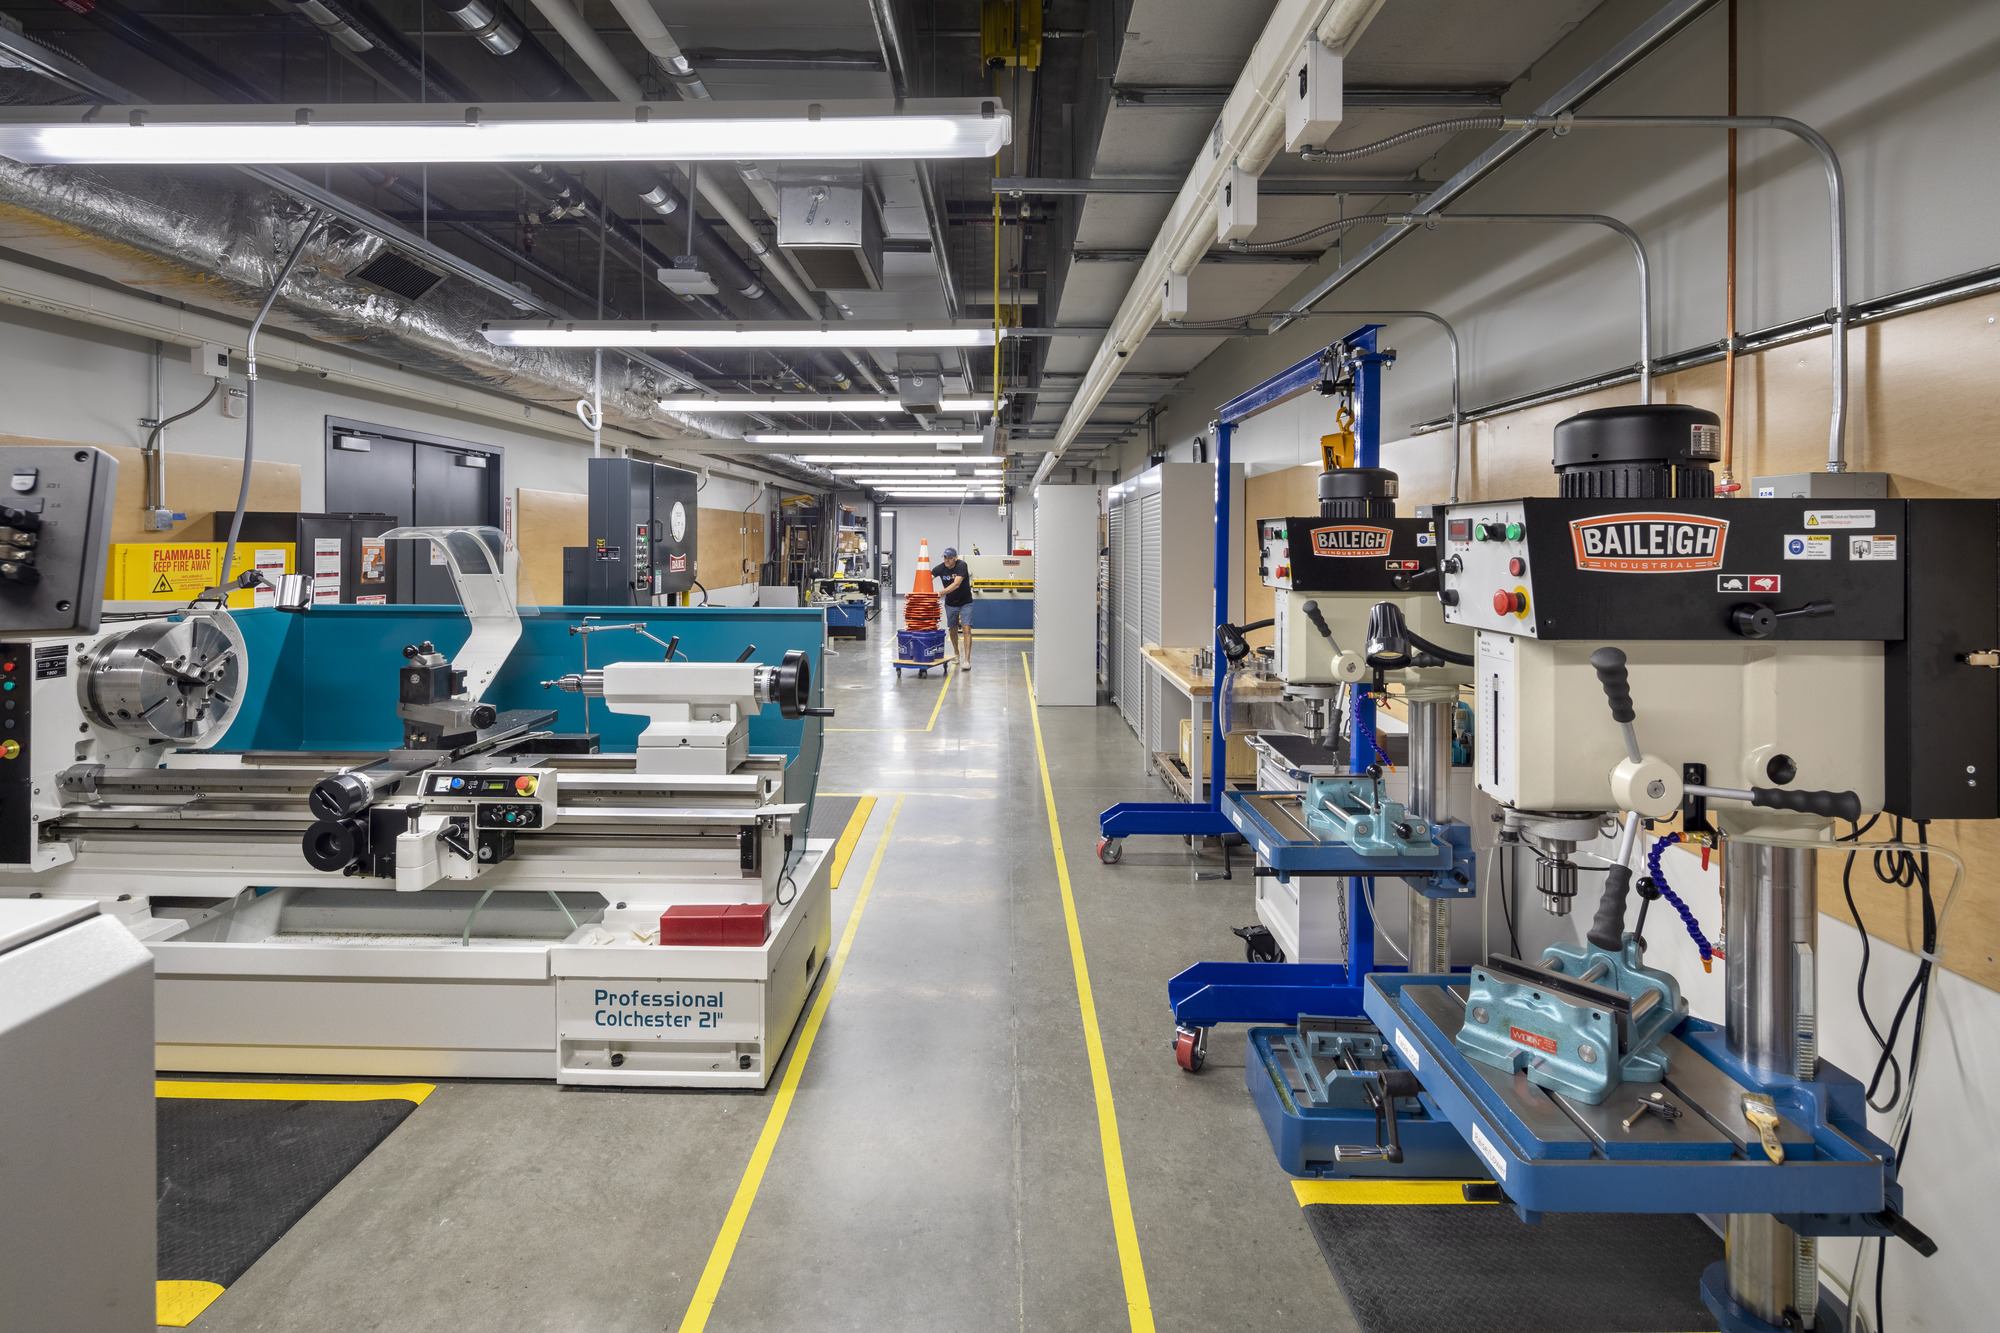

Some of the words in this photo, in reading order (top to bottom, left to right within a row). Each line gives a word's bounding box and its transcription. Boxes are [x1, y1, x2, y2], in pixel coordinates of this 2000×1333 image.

[1317, 531, 1387, 548] BAILEIGH
[1583, 524, 1716, 555] BAILEIGH
[153, 549, 211, 561] FLAMMABLE
[153, 561, 171, 573] KEEP
[173, 560, 192, 572] FIRE
[192, 560, 211, 571] AWAY
[671, 560, 685, 569] DAKE
[1603, 561, 1692, 569] INDUSTRIAL
[594, 989, 723, 1007] Professional
[594, 1010, 692, 1027] Colchester
[698, 1011, 723, 1028] 21"
